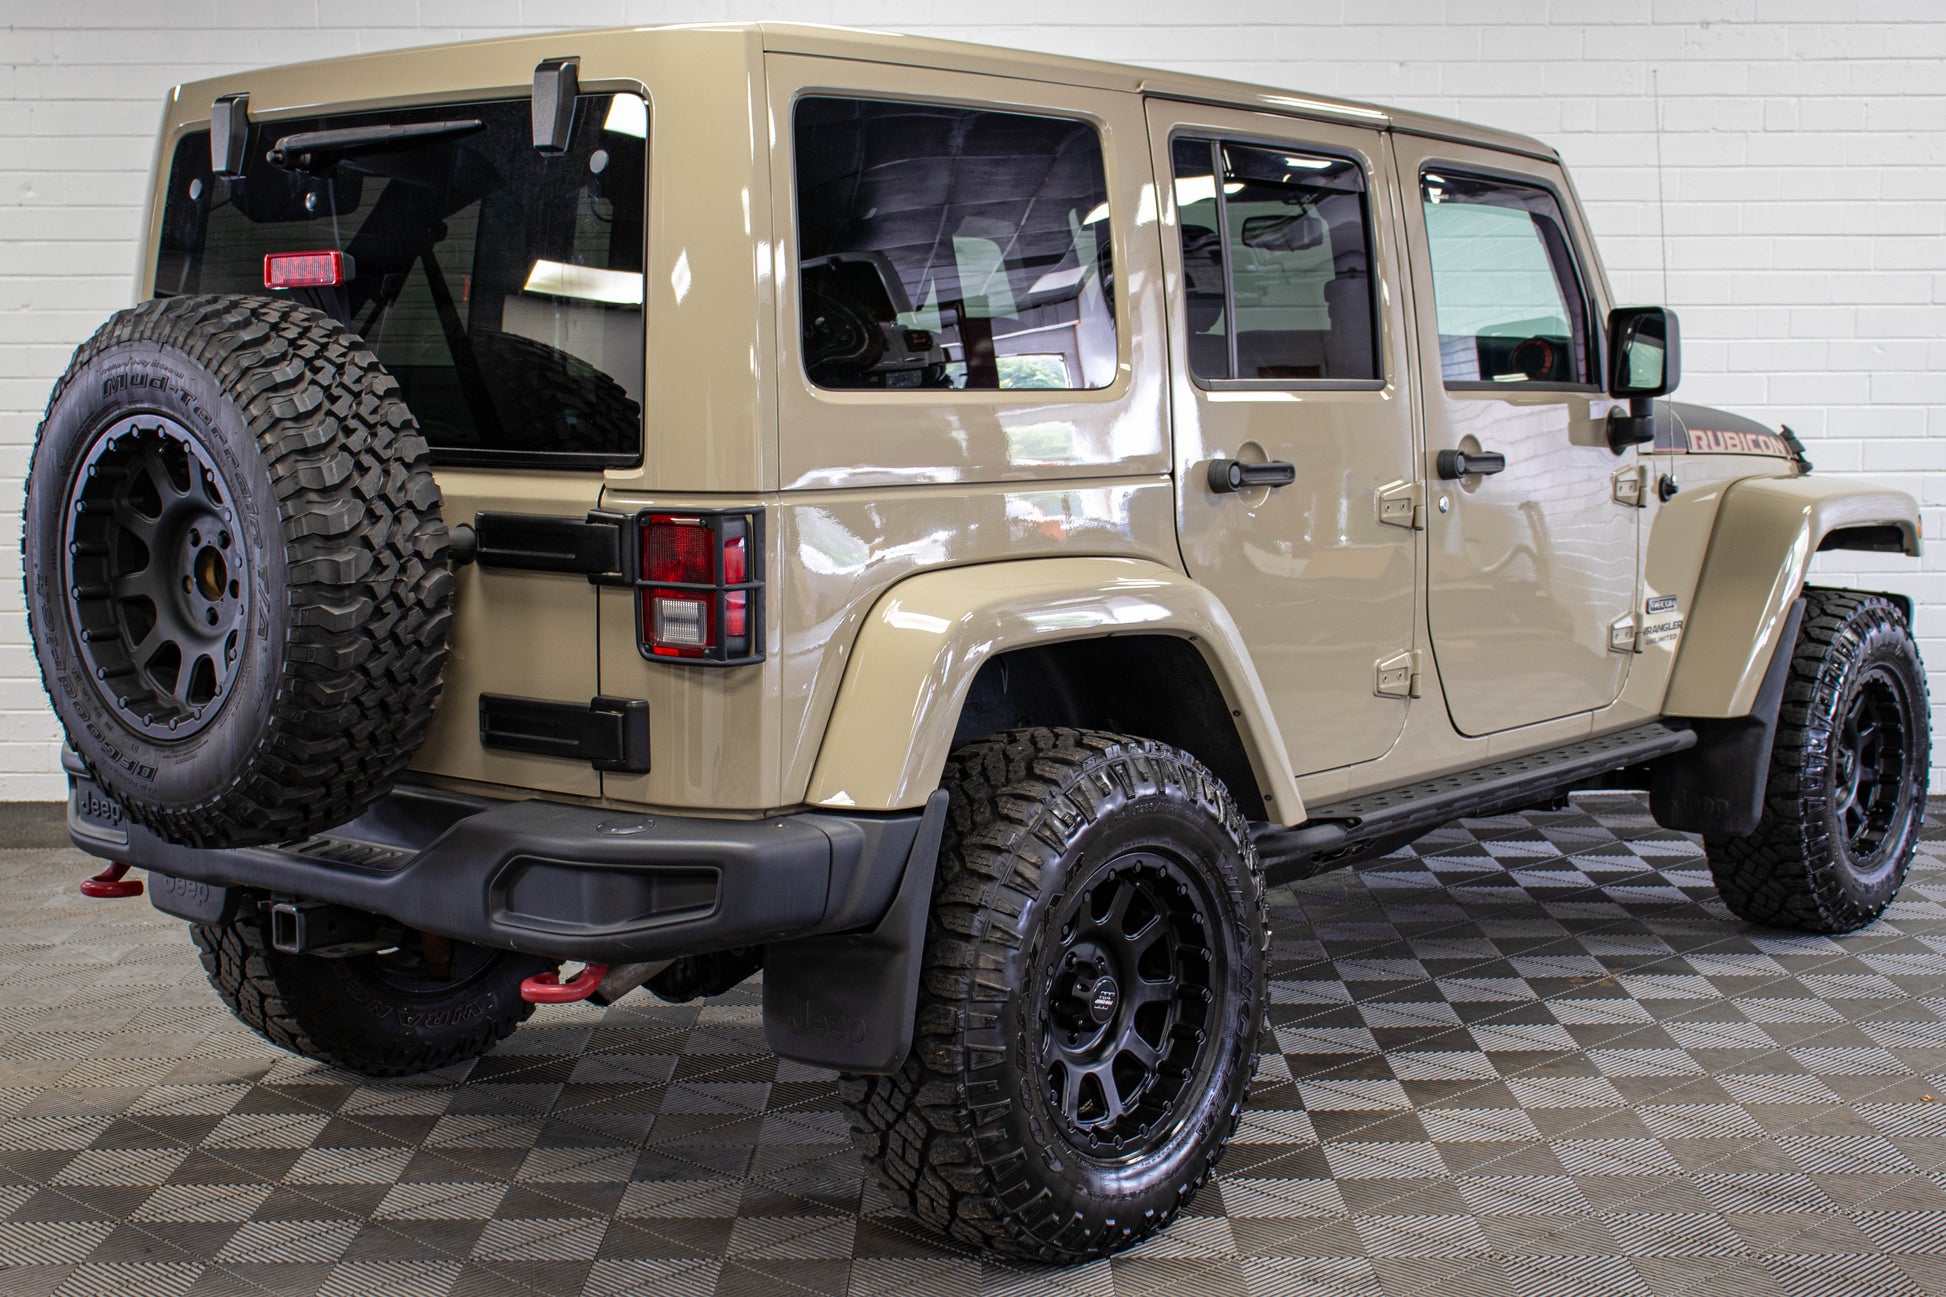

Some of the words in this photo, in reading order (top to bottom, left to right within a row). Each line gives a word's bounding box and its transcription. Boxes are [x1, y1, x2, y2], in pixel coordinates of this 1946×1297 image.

[1687, 428, 1787, 456] RUBICON
[81, 790, 122, 826] Jeep
[163, 876, 210, 906] Jeep
[784, 1000, 866, 1047] Jeep
